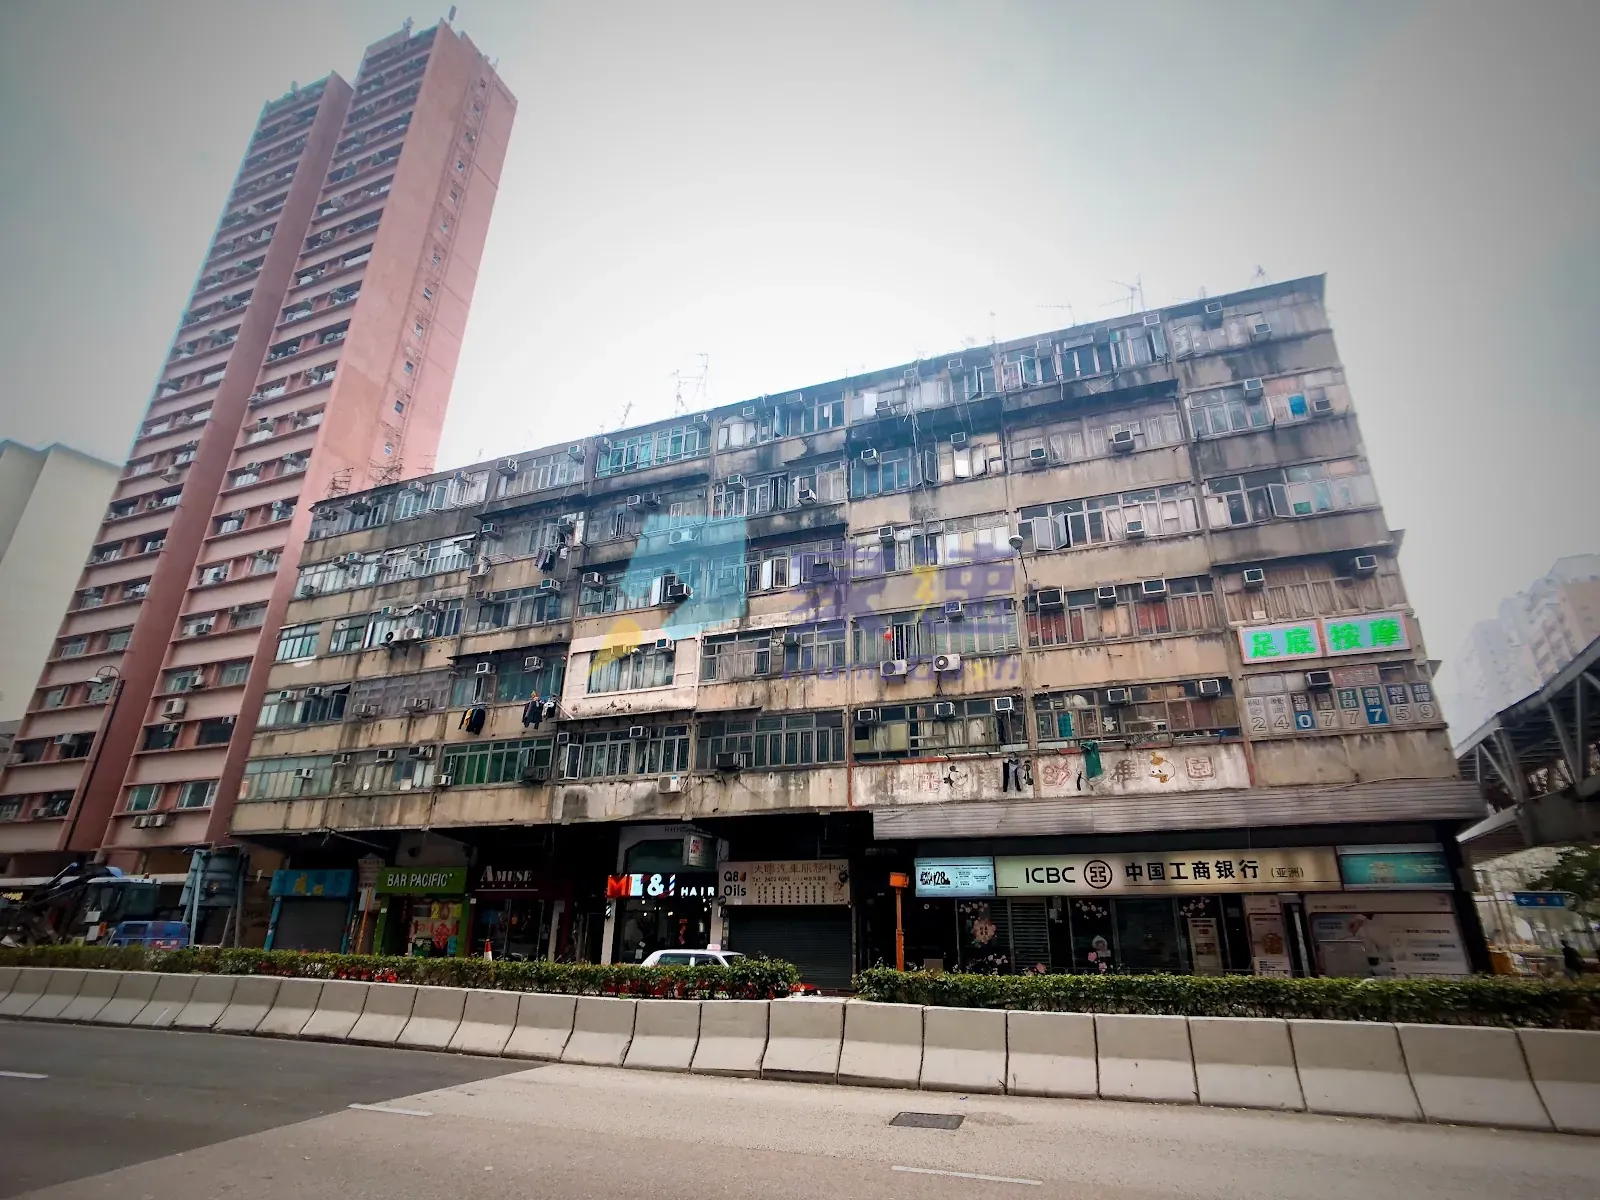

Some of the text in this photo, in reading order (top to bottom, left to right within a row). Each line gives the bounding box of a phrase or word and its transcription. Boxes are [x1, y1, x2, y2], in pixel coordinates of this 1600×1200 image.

[1251, 618, 1402, 658] 足底按摩
[723, 871, 739, 883] Q8
[1025, 866, 1075, 884] ICBC
[1125, 859, 1260, 882] 中国工商银行
[387, 873, 407, 887] BAR
[409, 873, 448, 887] PACIFIC
[680, 886, 715, 897] HAIR
[723, 884, 747, 897] Oils
